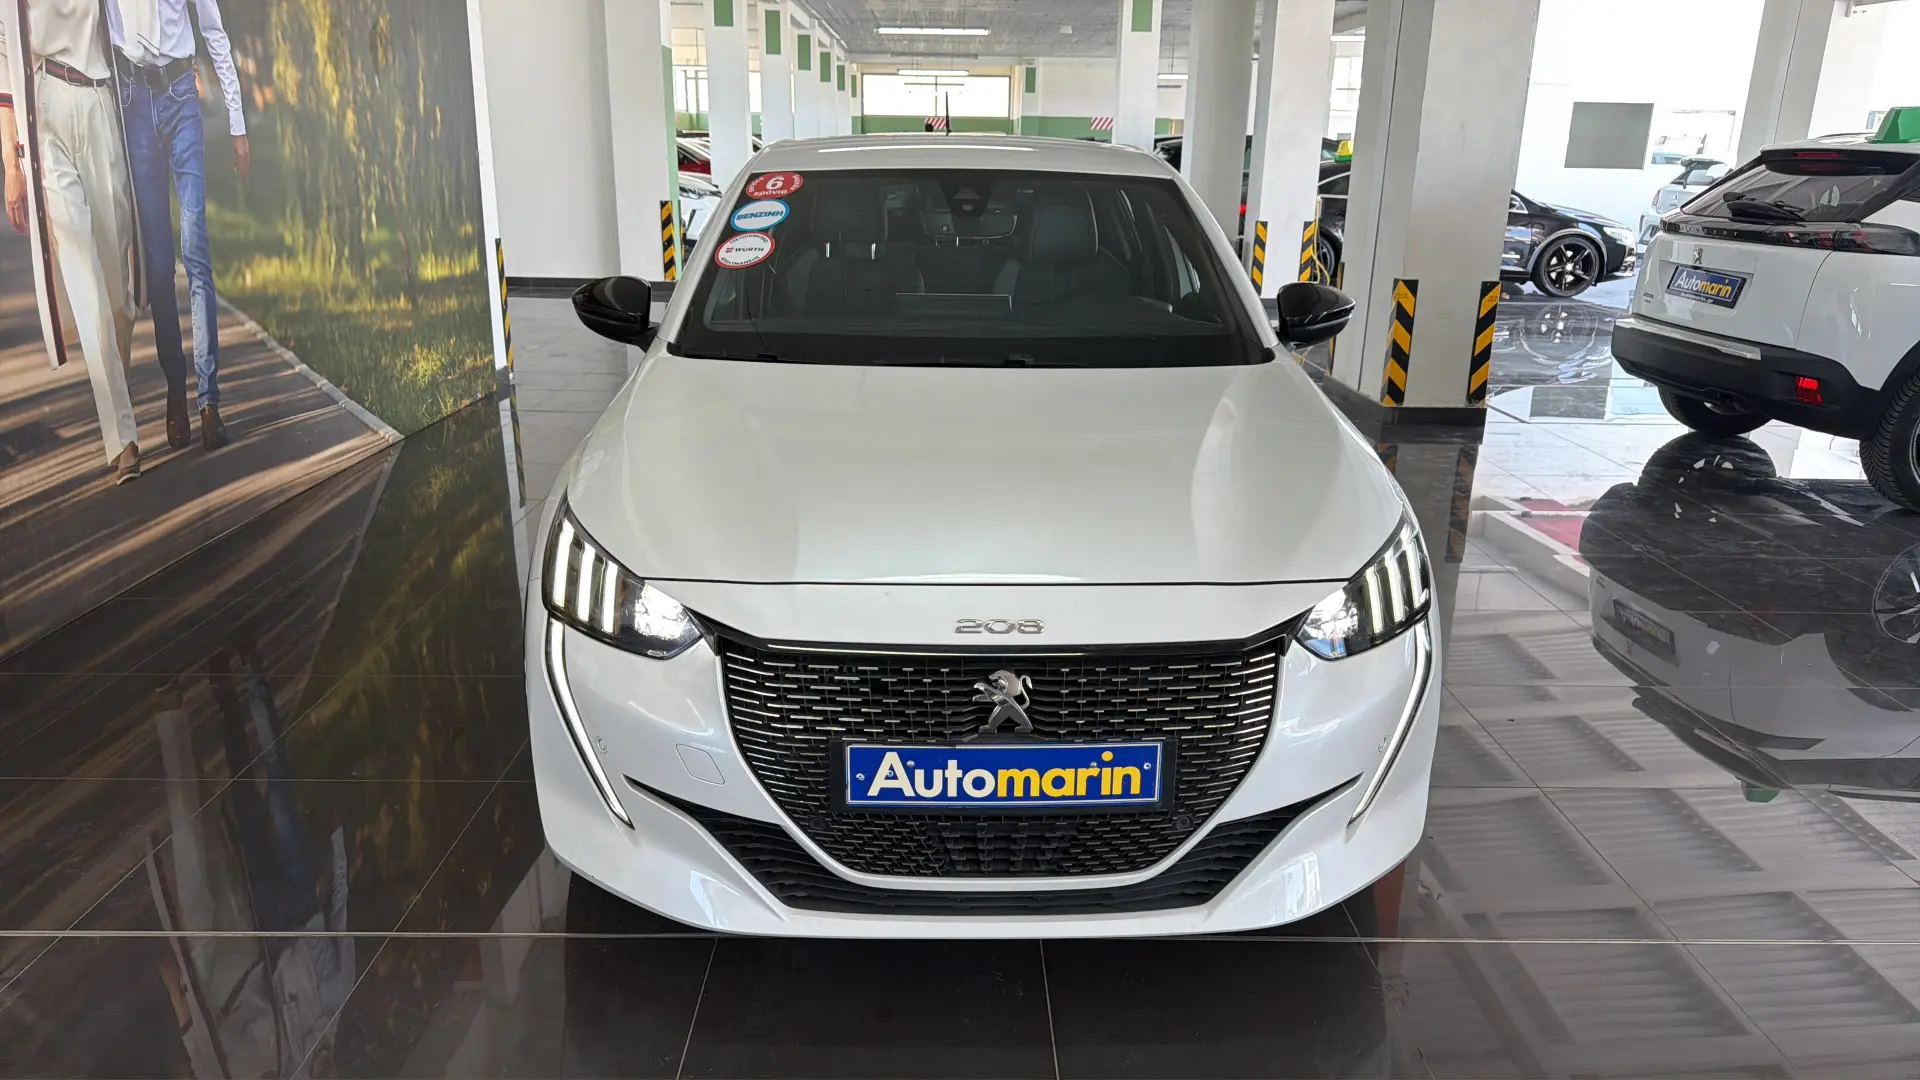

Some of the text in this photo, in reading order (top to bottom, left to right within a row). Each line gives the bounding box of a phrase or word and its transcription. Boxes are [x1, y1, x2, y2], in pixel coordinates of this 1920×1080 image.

[766, 175, 785, 190] 6
[1675, 271, 1732, 298] Automarin
[955, 619, 1044, 634] 208
[867, 751, 1141, 798] Automarin
